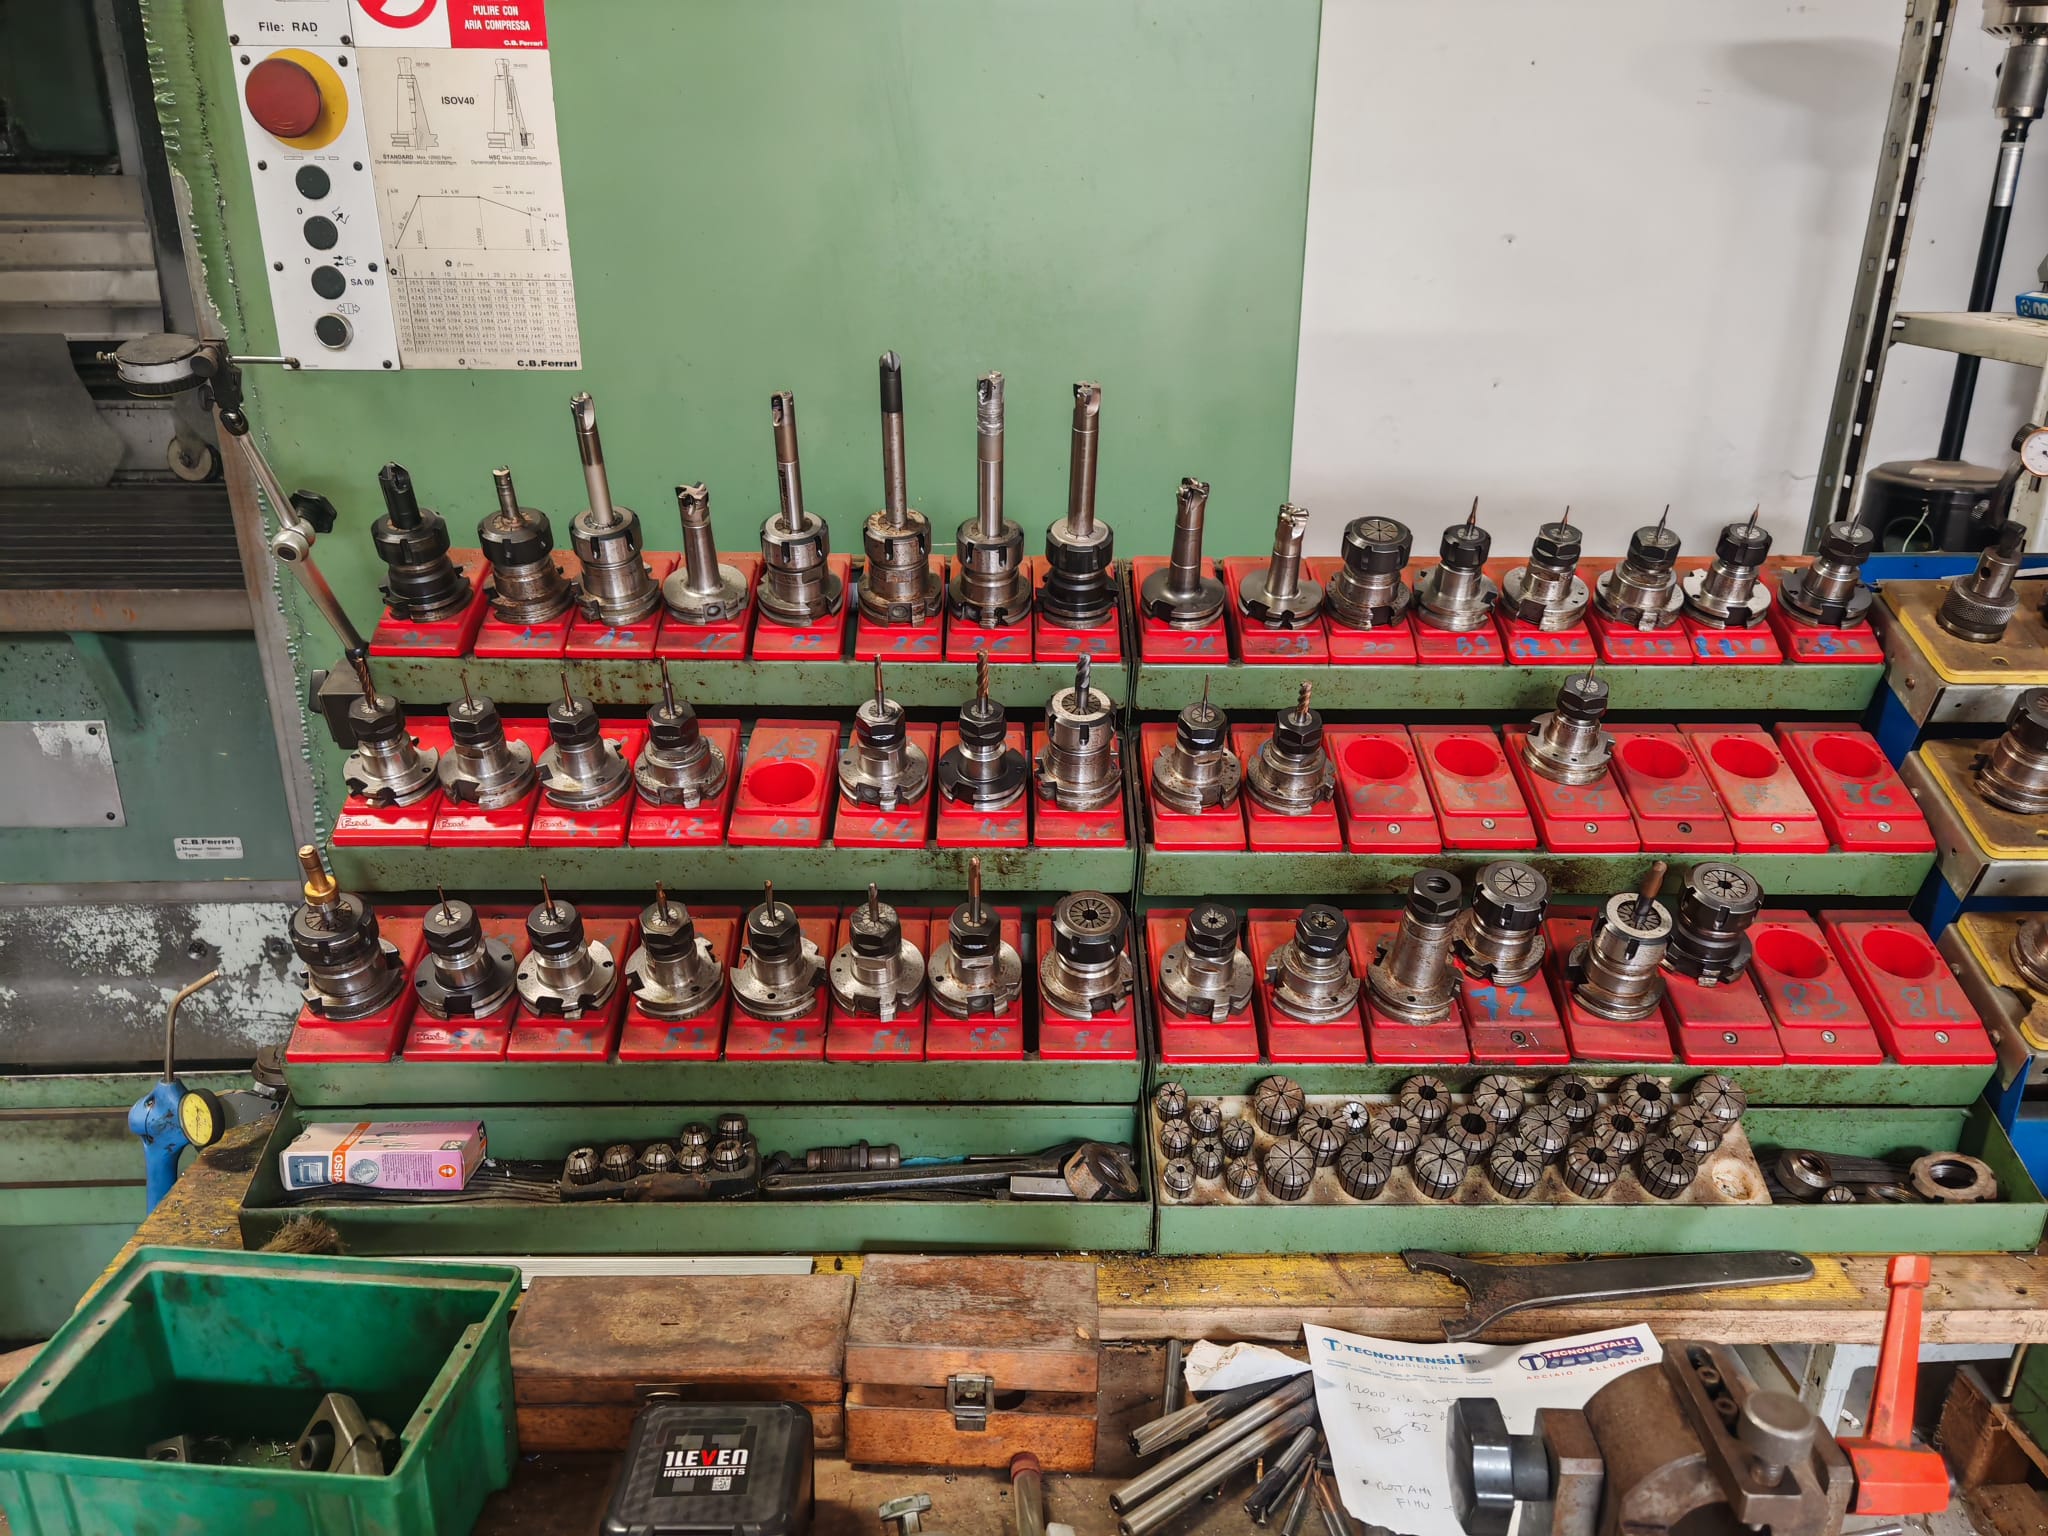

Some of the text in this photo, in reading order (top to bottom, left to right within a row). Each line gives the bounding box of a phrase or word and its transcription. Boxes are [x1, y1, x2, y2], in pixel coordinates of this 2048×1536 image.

[473, 5, 519, 16] PULIRE CON
[258, 21, 318, 32] File: RAD
[464, 19, 531, 31] ARIA COMPRESSA
[441, 96, 475, 105] ISOV40
[350, 278, 375, 287] SA 09
[516, 359, 578, 368] C.B.Ferrari
[1469, 986, 1534, 1020] 72
[1782, 980, 1848, 1019] 83
[1900, 985, 1961, 1023] 84
[1544, 1338, 1637, 1359] TECNOMETALLI
[1588, 1356, 1651, 1373] ALLUMINIO
[663, 1468, 746, 1478] INSTRUMENTS
